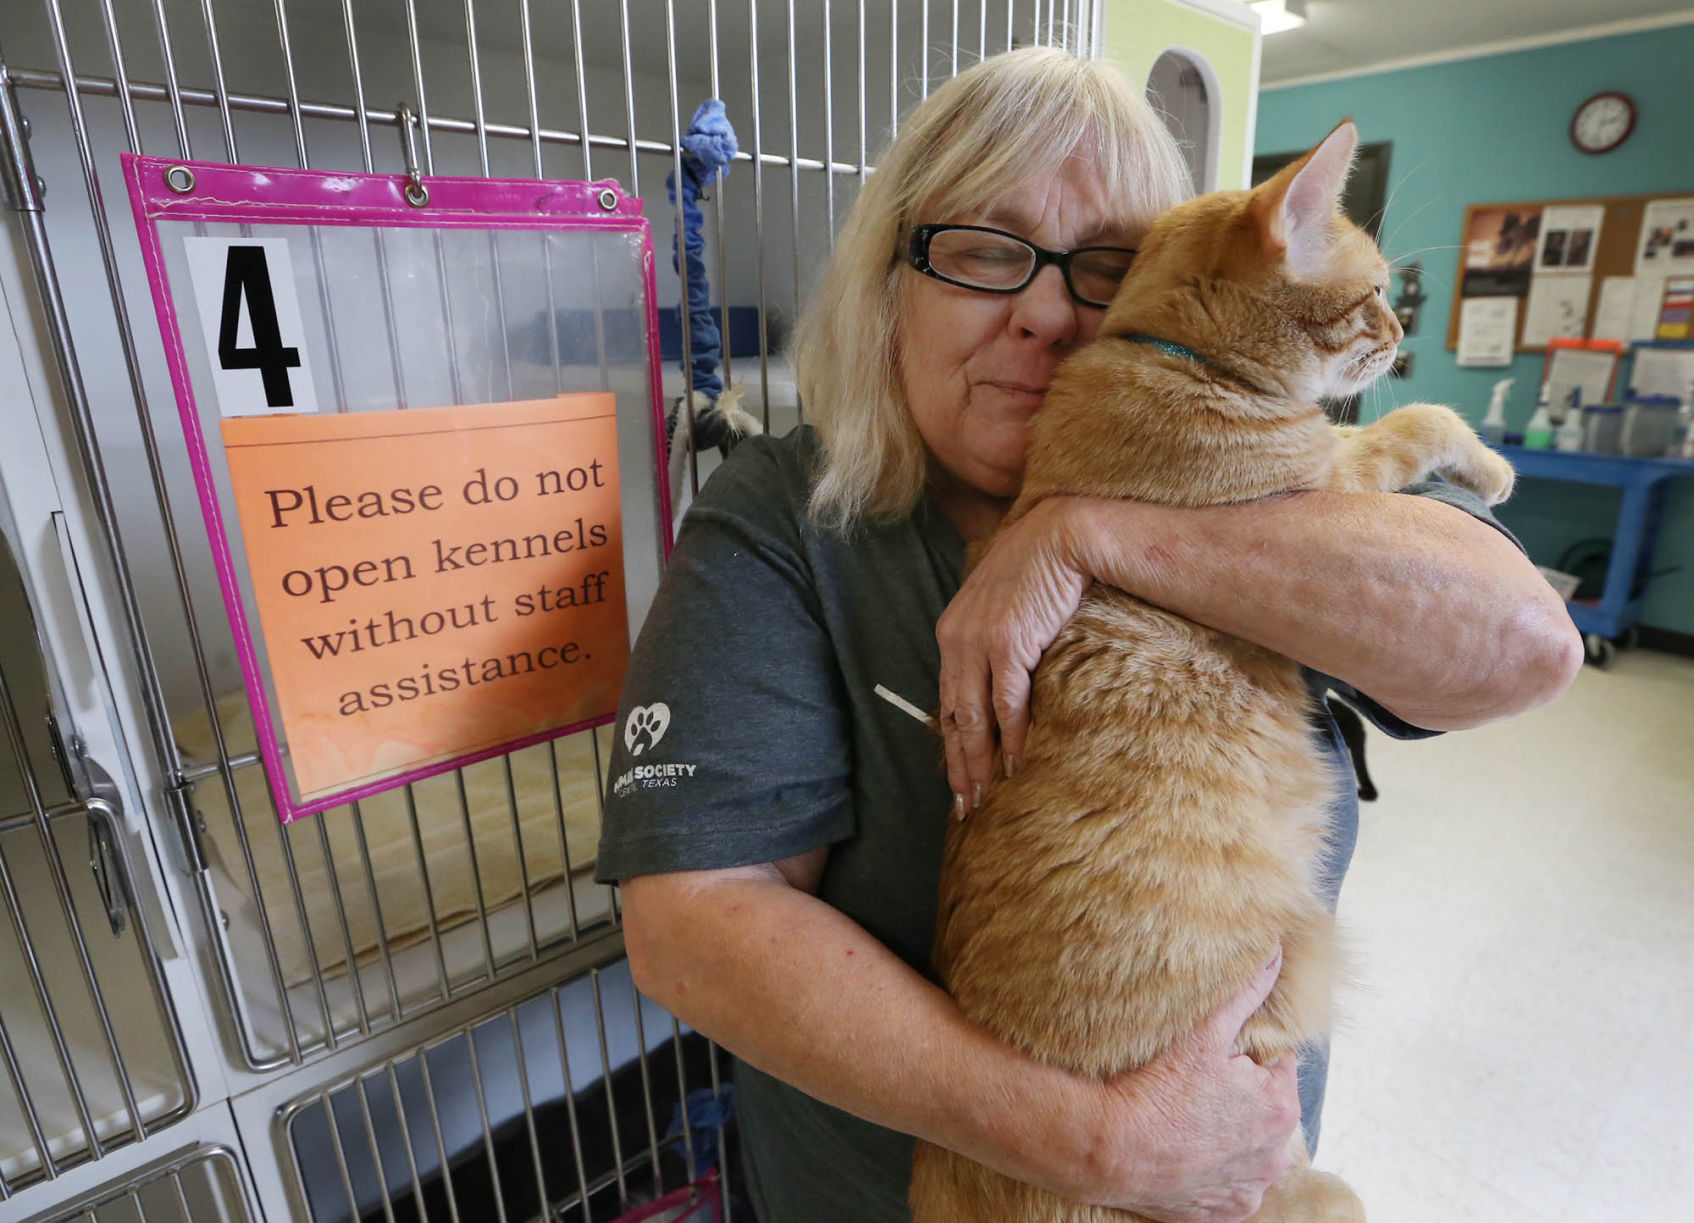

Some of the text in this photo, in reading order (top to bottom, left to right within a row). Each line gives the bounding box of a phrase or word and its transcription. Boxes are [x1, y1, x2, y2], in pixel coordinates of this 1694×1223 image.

[218, 246, 301, 408] 4
[264, 458, 605, 529] Please do not
[281, 518, 608, 604] open kennels
[301, 572, 608, 661] without staff
[338, 640, 593, 717] assistance.
[634, 764, 696, 779] SOCIETY
[642, 778, 677, 788] TEXAS
